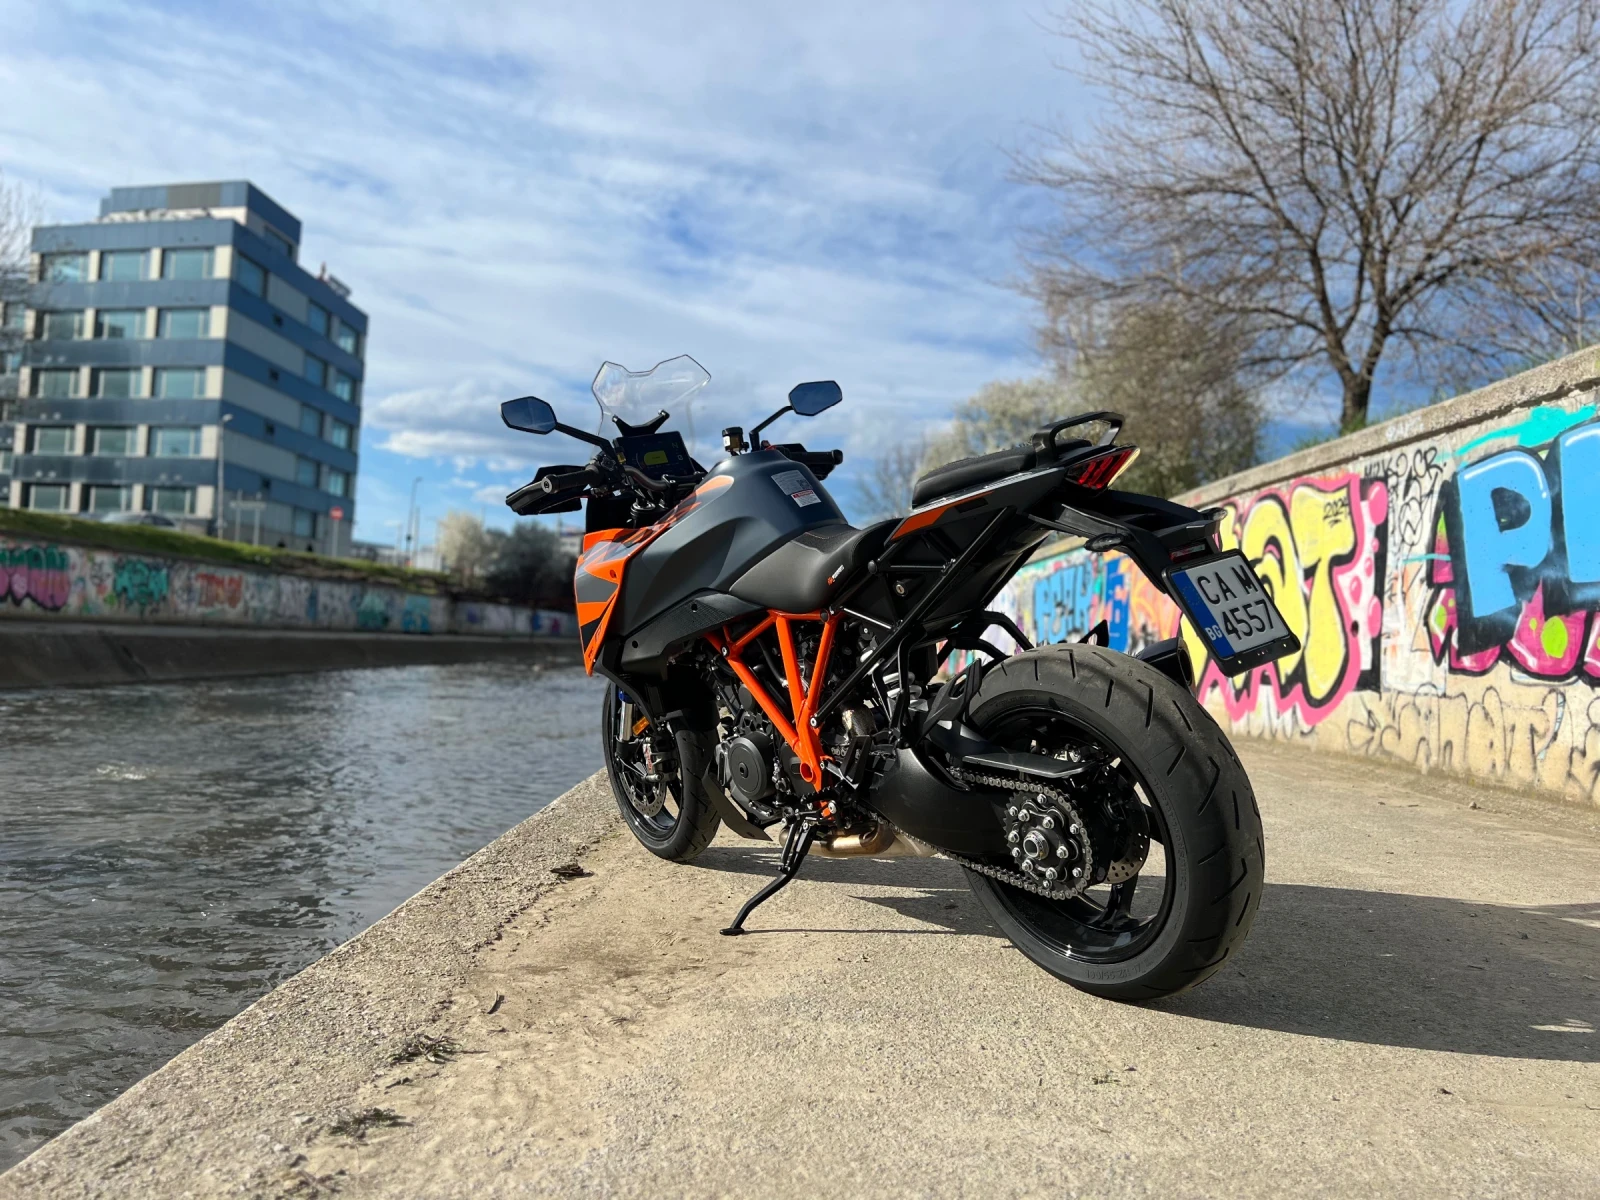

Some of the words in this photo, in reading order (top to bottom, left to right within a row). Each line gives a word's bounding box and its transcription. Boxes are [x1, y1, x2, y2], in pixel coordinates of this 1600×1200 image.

[1197, 571, 1238, 605] CA
[1231, 565, 1258, 594] M
[1205, 625, 1223, 641] BG
[1221, 599, 1273, 640] 4557
